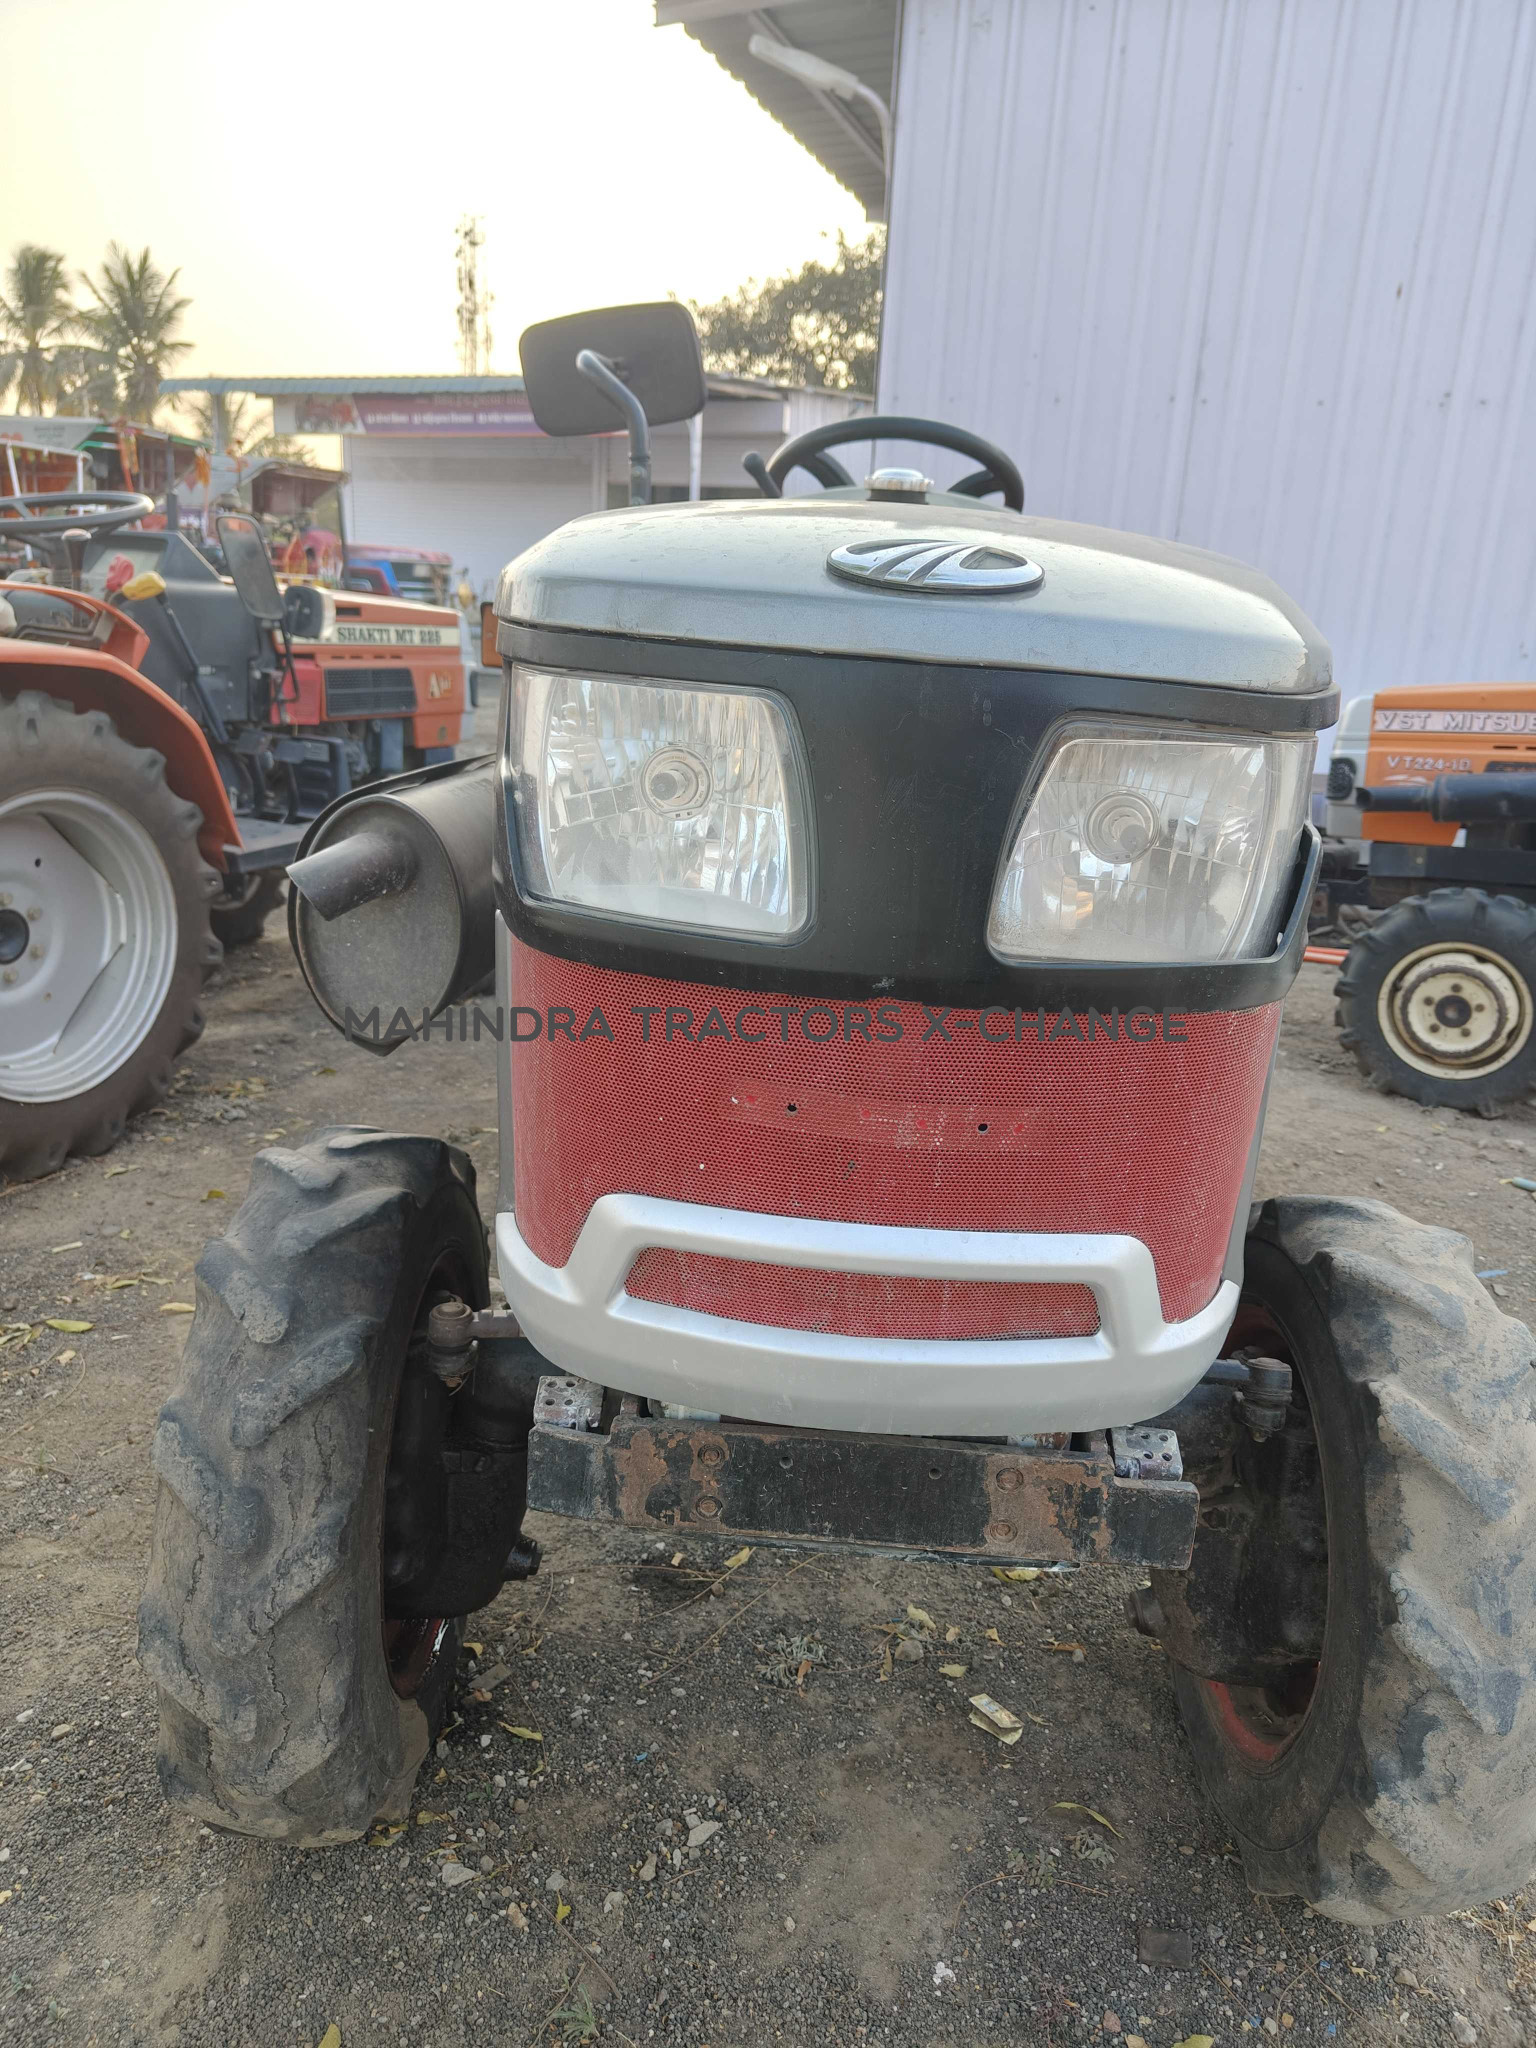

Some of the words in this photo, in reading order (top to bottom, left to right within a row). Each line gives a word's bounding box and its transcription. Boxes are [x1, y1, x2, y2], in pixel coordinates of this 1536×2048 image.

[337, 627, 391, 643] SHAKTI
[395, 628, 416, 644] MT
[1380, 712, 1431, 730] VST
